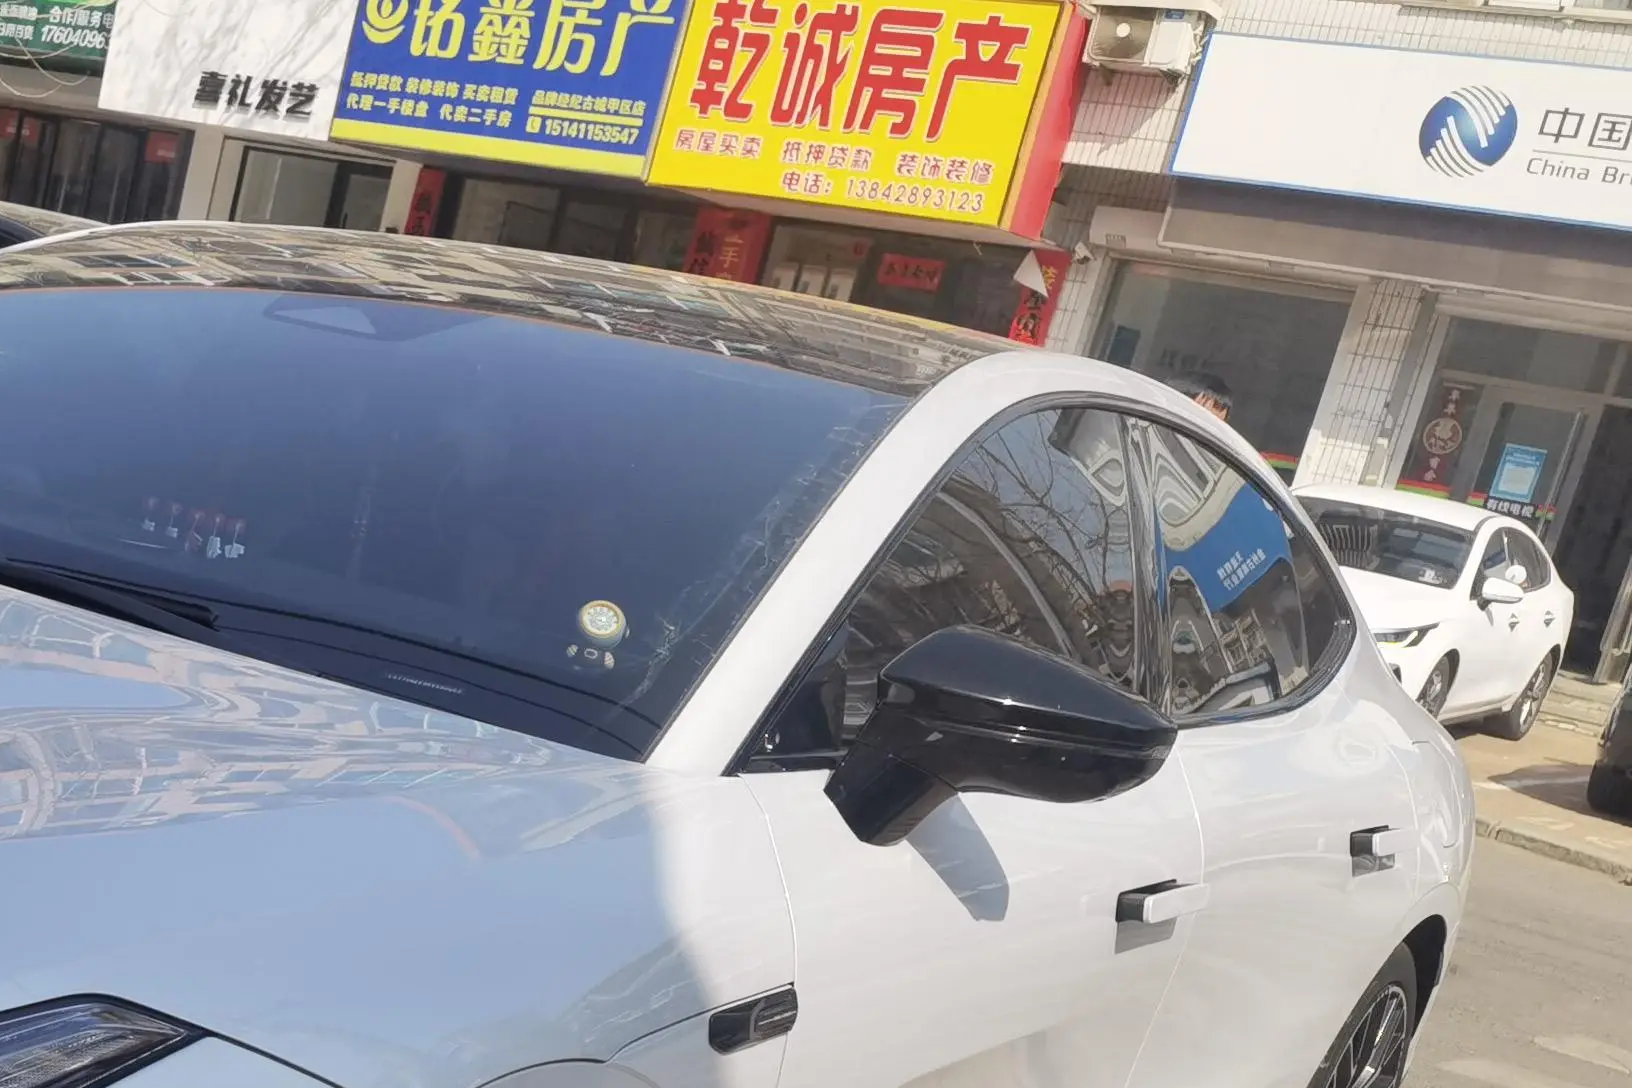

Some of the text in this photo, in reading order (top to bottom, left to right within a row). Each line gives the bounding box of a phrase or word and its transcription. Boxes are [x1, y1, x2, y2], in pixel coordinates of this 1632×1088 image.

[350, 71, 403, 92] 抵押贷款
[405, 77, 460, 98] 装修装饰
[689, 0, 1032, 141] 乾诚房产
[545, 119, 640, 145] 15141153547
[1538, 107, 1632, 151] 中国
[674, 128, 994, 185] 房屋买卖 抵押贷款 装饰装修
[1527, 158, 1632, 186] China Br
[846, 177, 985, 214] 13842893123
